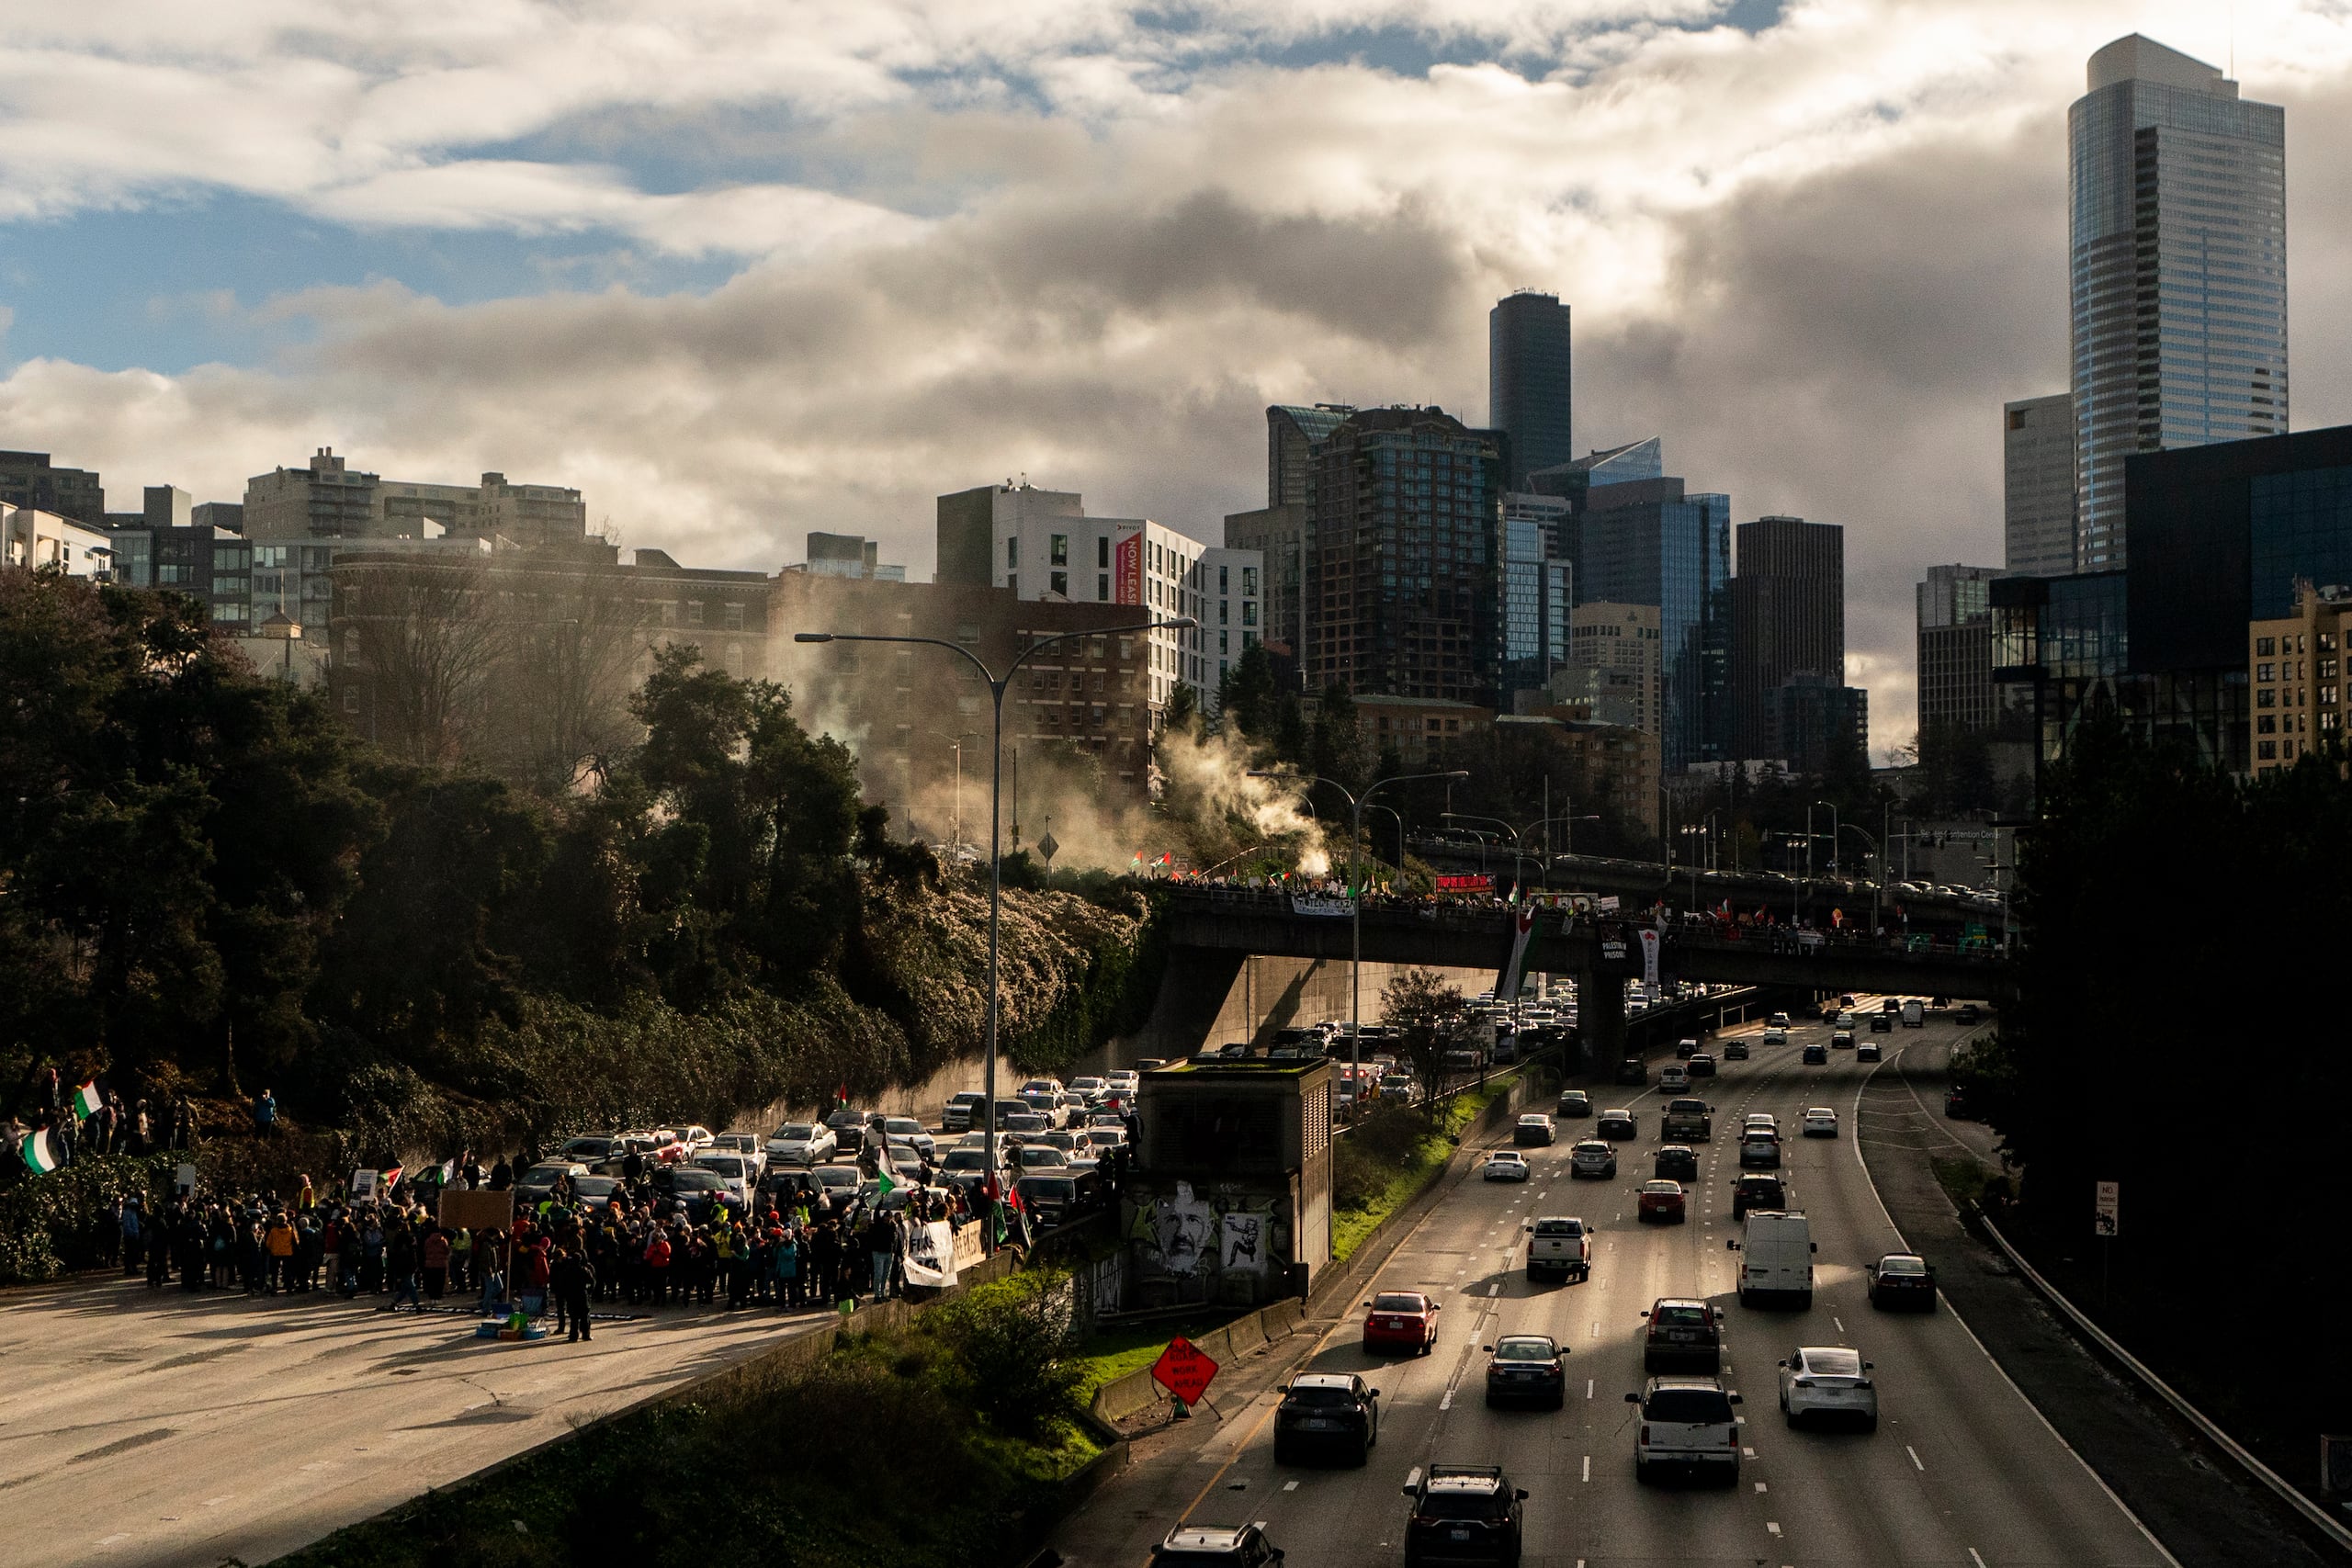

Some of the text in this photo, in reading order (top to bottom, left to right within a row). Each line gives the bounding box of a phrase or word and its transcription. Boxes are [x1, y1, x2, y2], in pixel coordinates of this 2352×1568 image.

[1127, 541, 1137, 569] NOW
[1942, 829, 1980, 838] Cnvention
[2102, 1186, 2113, 1194] NO
[1171, 1365, 1198, 1375] WORK
[1174, 1378, 1204, 1388] AHEAD
